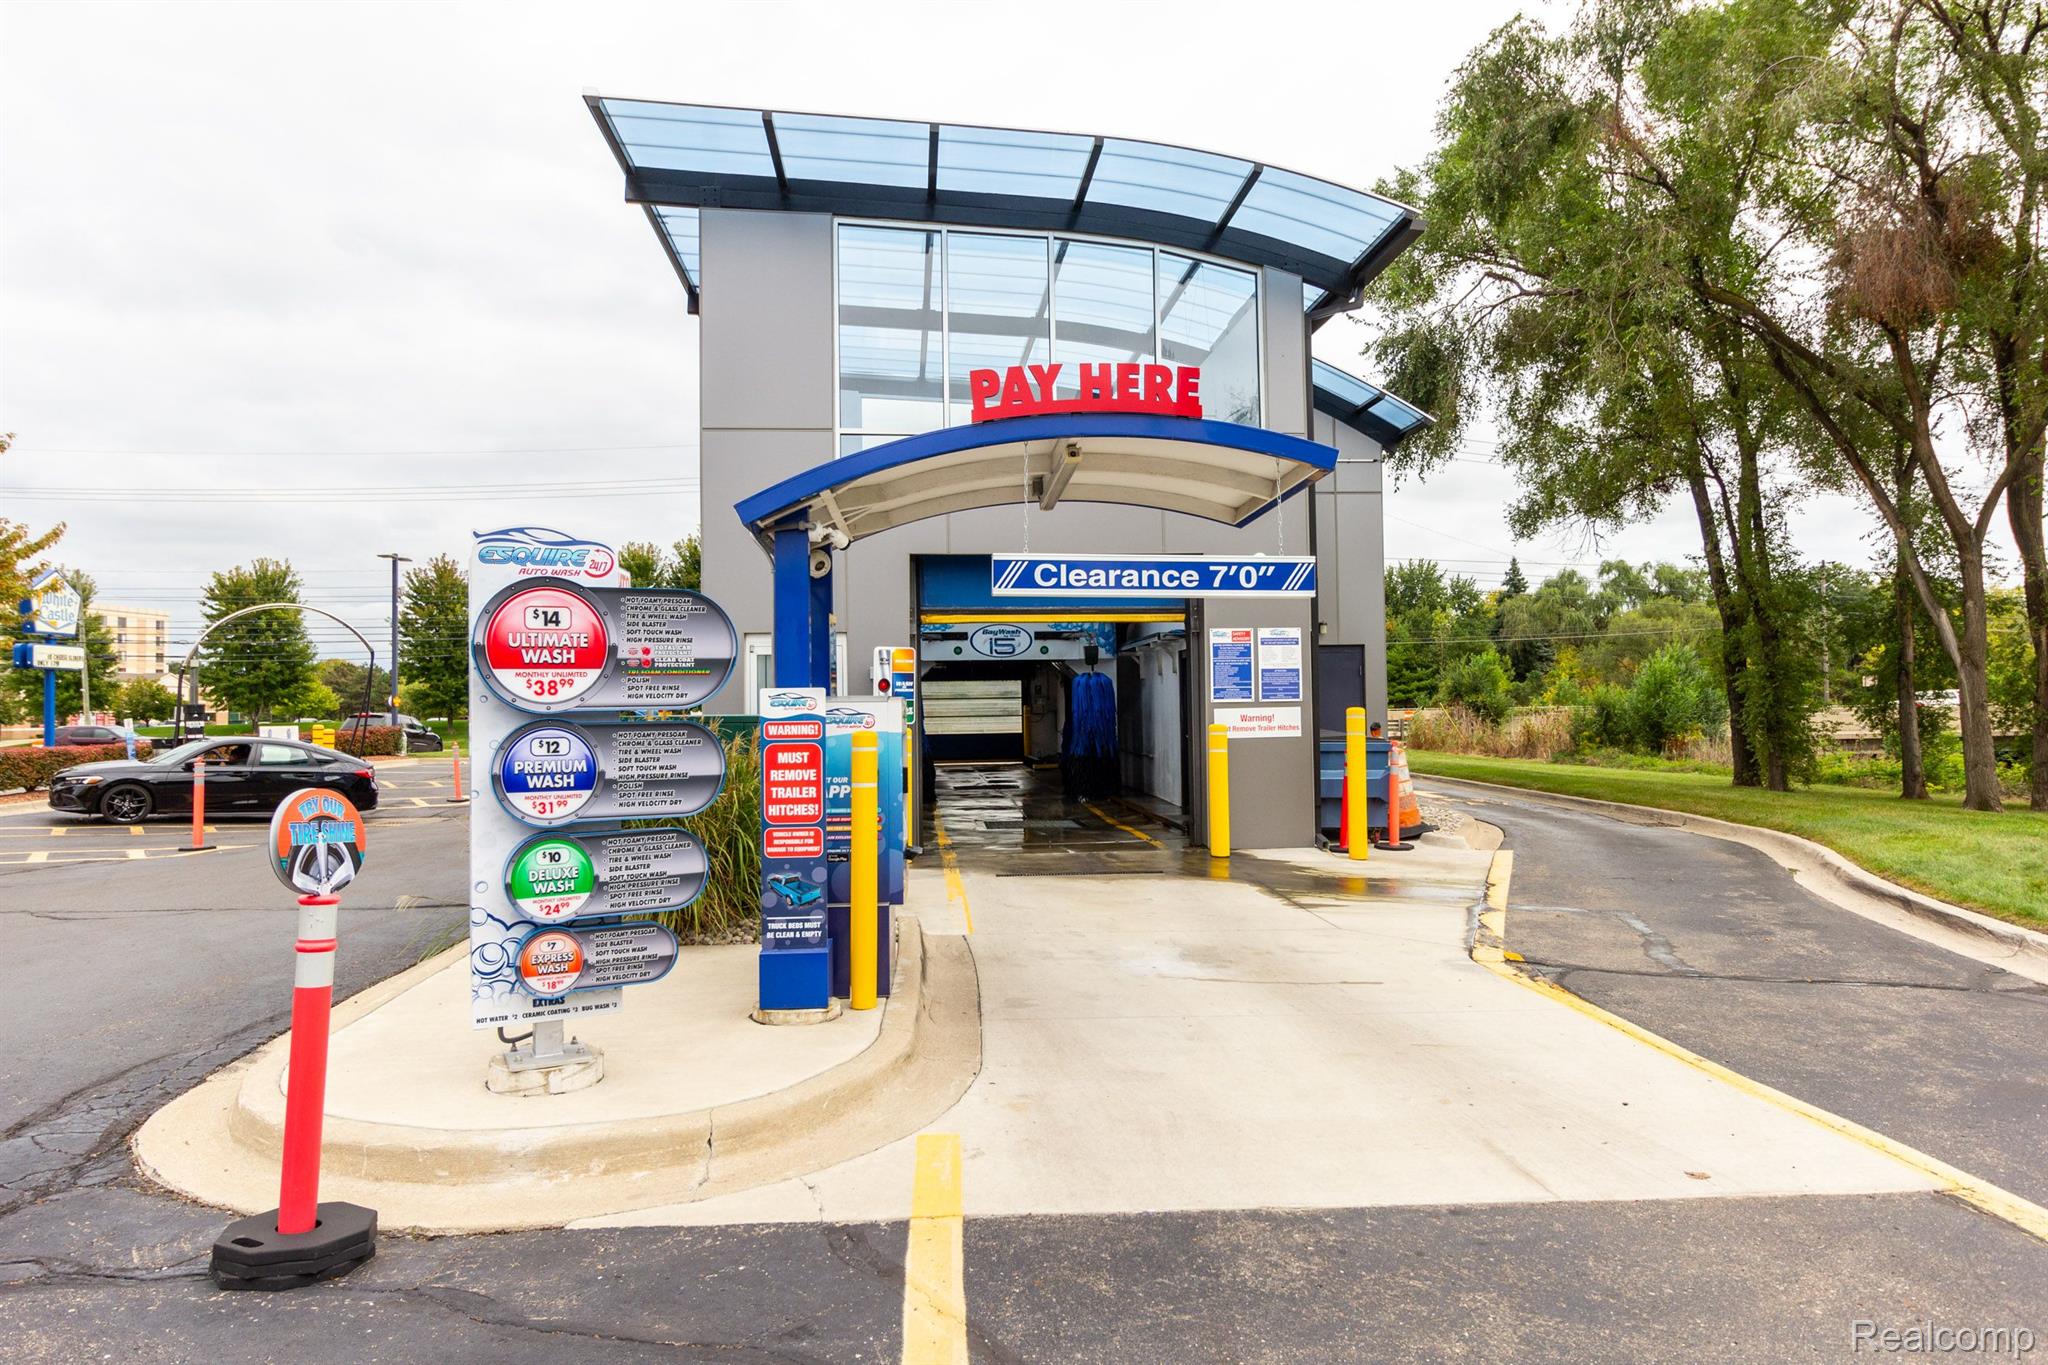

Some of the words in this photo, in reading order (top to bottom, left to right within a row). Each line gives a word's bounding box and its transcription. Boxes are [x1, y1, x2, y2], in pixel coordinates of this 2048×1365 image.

[970, 363, 1063, 414] PAY
[1079, 363, 1201, 410] HERE
[478, 546, 590, 567] ESQUIRE
[518, 568, 548, 576] AUTO
[1033, 563, 1200, 588] Clearance
[40, 606, 75, 621] Castle
[533, 609, 560, 626] $14
[508, 632, 588, 647] ULTIMATE
[521, 649, 575, 663] WASH
[1240, 714, 1275, 723] Warning!
[768, 724, 819, 735] WARNING!
[539, 740, 560, 753] $12
[778, 752, 809, 763] MUST
[514, 760, 587, 774] PREMIUM
[527, 774, 574, 788] WASH
[770, 769, 817, 781] REMOVE
[771, 787, 816, 798] TRAILER
[298, 797, 319, 819] TRY
[322, 796, 344, 817] OUR
[768, 804, 819, 815] HITCHES!
[289, 822, 319, 845] TIRE
[321, 821, 355, 842] SHINE
[543, 851, 561, 863] $10
[625, 863, 650, 871] BLASTER
[528, 867, 579, 882] DELUXE
[533, 880, 575, 894] WASH
[531, 952, 574, 965] EXPRESS
[537, 964, 568, 975] WASH
[522, 1010, 546, 1018] CERAMIC
[547, 1008, 570, 1016] COATING
